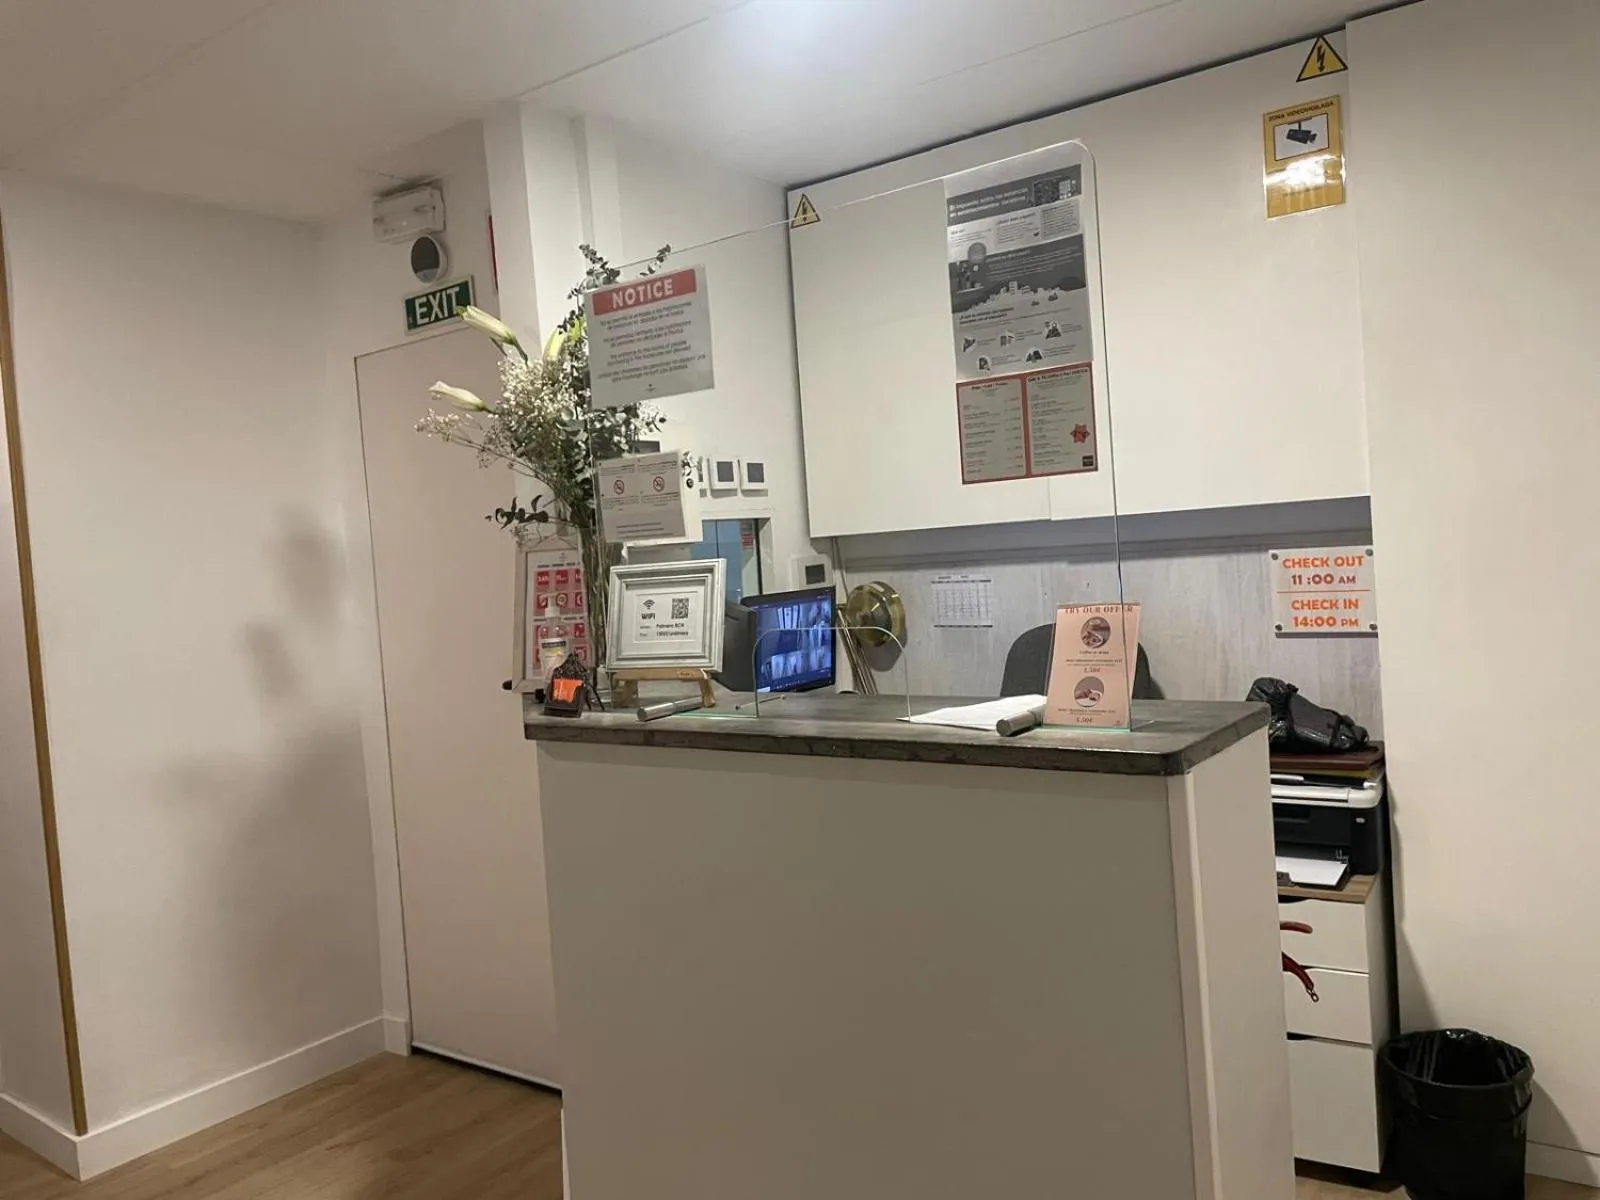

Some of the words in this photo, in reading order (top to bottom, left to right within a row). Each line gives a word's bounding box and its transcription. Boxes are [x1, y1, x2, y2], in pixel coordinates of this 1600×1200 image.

[611, 279, 674, 309] NOTICE
[415, 287, 460, 325] EXIT
[1282, 557, 1330, 569] CHECK
[1334, 555, 1364, 567] OUT
[1338, 575, 1356, 584] AM
[1103, 605, 1133, 613] OFFR
[1291, 599, 1339, 610] CHECK
[1343, 598, 1359, 609] IN
[1293, 616, 1337, 627] 14:00
[1341, 618, 1359, 627] PM
